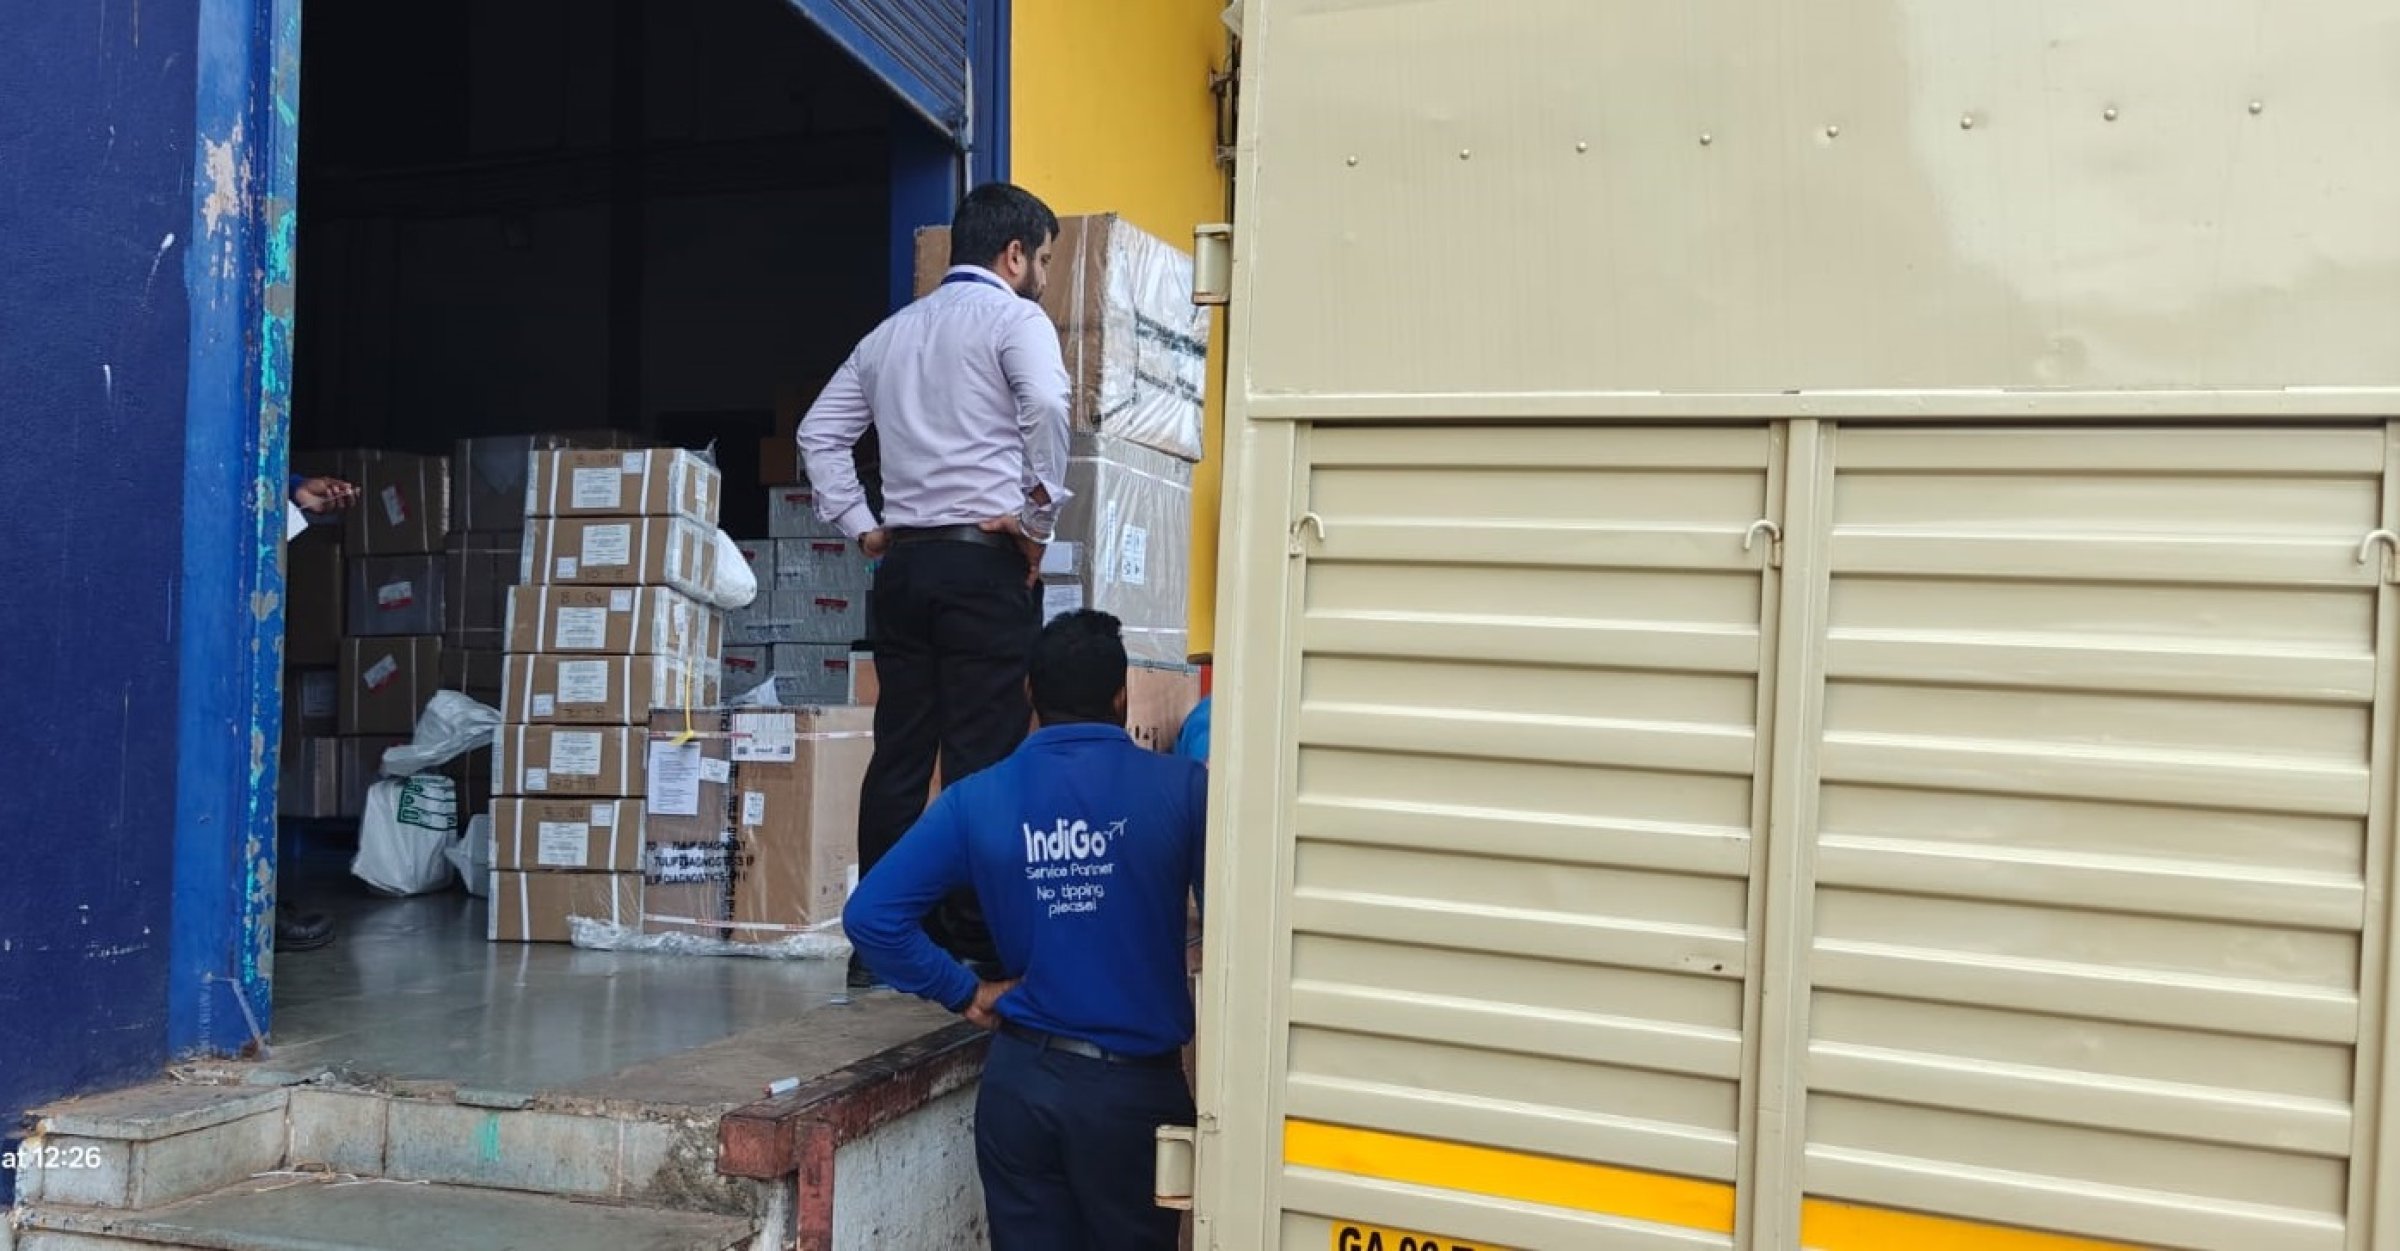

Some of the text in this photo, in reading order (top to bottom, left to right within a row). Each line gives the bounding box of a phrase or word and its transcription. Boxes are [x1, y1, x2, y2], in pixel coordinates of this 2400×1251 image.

[1023, 818, 1106, 863] IndiGo
[1025, 863, 1115, 880] Service Partner
[1037, 882, 1105, 901] No tipping
